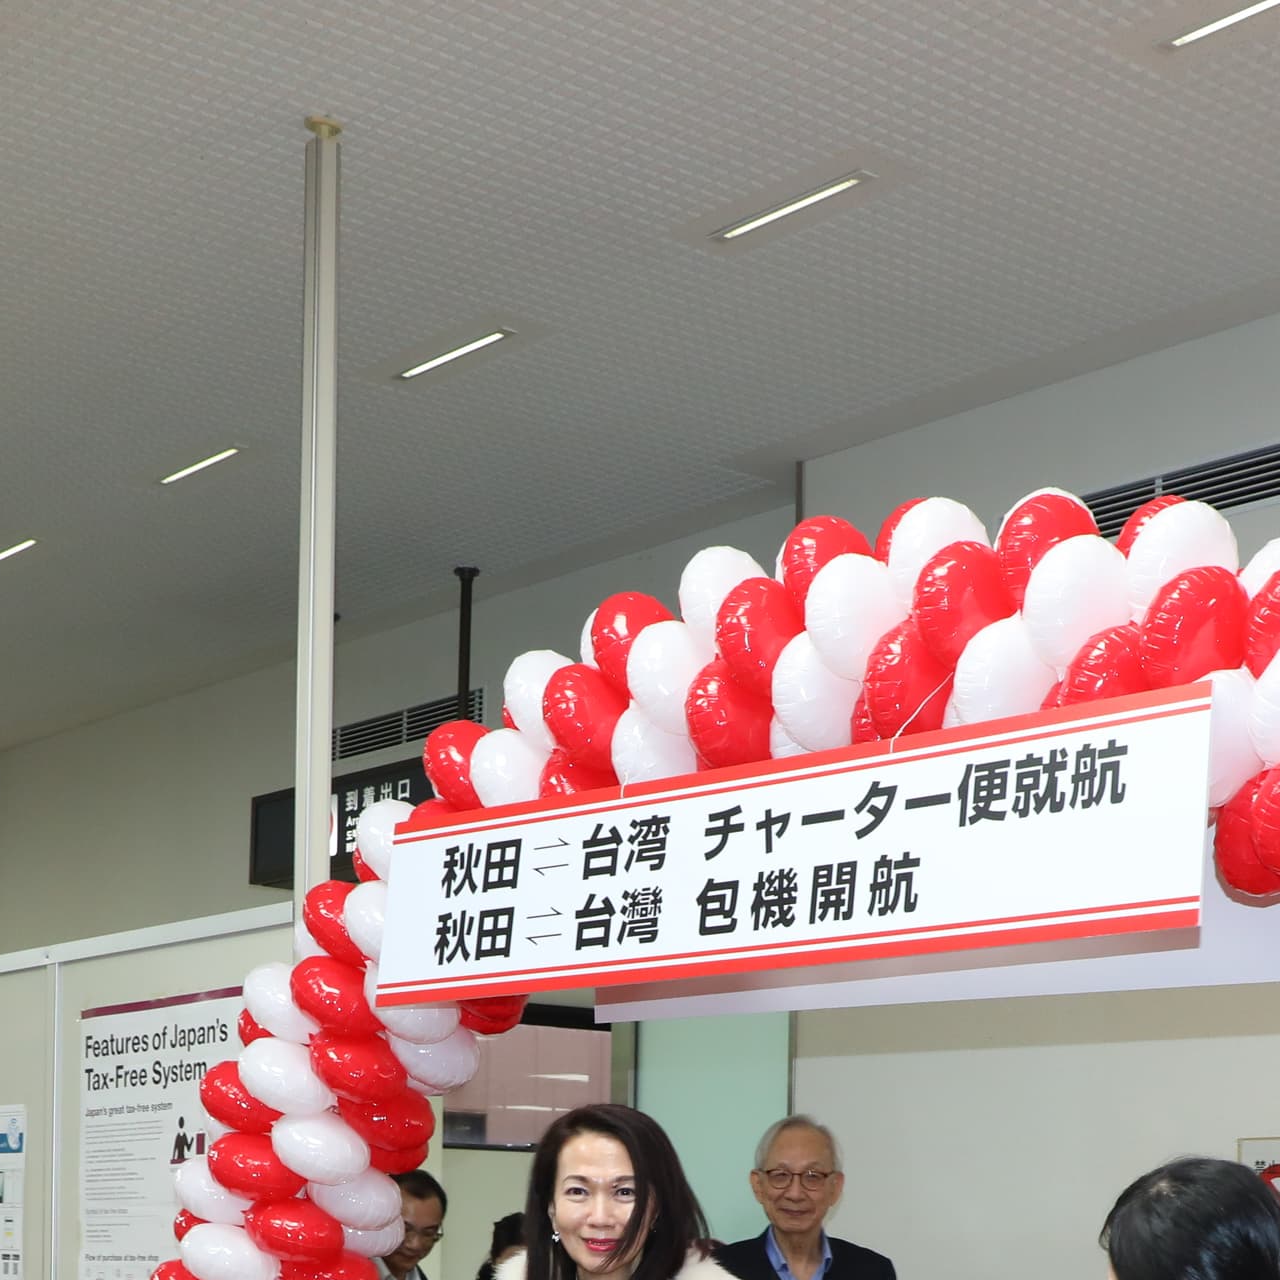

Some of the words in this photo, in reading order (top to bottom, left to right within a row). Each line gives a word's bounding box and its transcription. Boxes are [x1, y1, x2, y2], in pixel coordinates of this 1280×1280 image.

[345, 778, 411, 812] 到着出口
[441, 838, 522, 898] 秋田
[582, 814, 671, 881] 台湾
[704, 739, 1128, 861] チャーター便就航
[434, 907, 515, 966] 秋田
[575, 886, 663, 951] 台灣
[696, 851, 920, 936] 包機開航
[85, 1033, 148, 1058] Features
[152, 1026, 168, 1049] of
[170, 1018, 228, 1051] Japan's
[85, 1065, 148, 1091] Tax-Free
[152, 1060, 207, 1089] System
